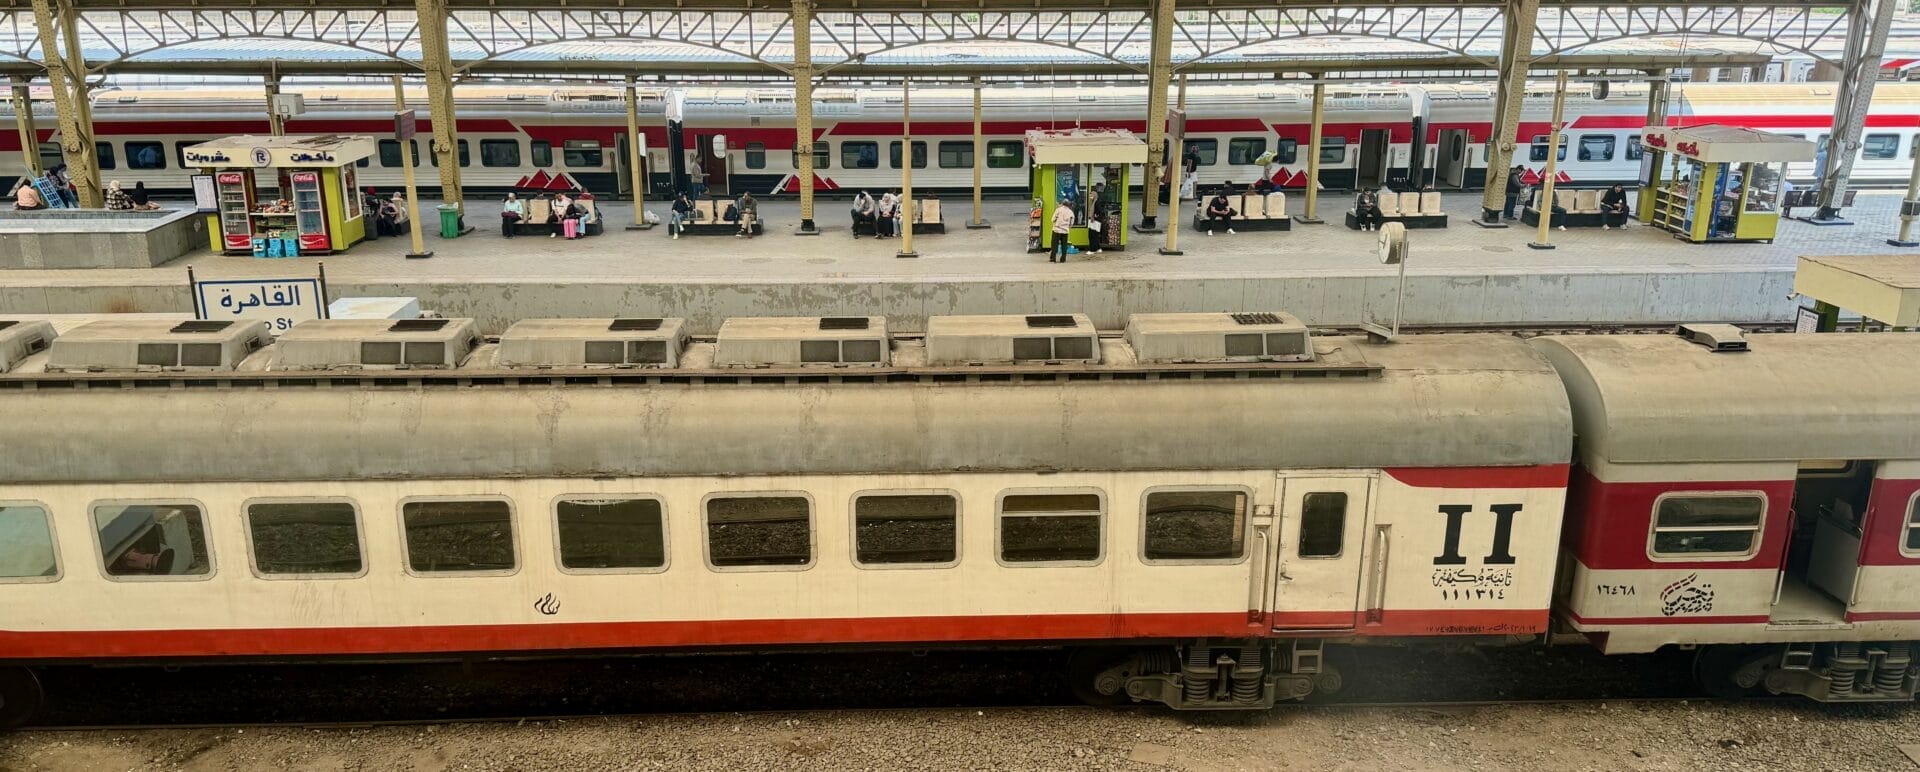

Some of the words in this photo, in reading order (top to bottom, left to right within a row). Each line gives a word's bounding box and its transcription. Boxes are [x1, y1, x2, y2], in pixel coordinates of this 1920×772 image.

[186, 150, 231, 163] مشروبات
[221, 285, 301, 314] القاهرة
[1442, 588, 1505, 600] ١١١٣١٤
[1597, 584, 1635, 595] ١٦٤٦٨
